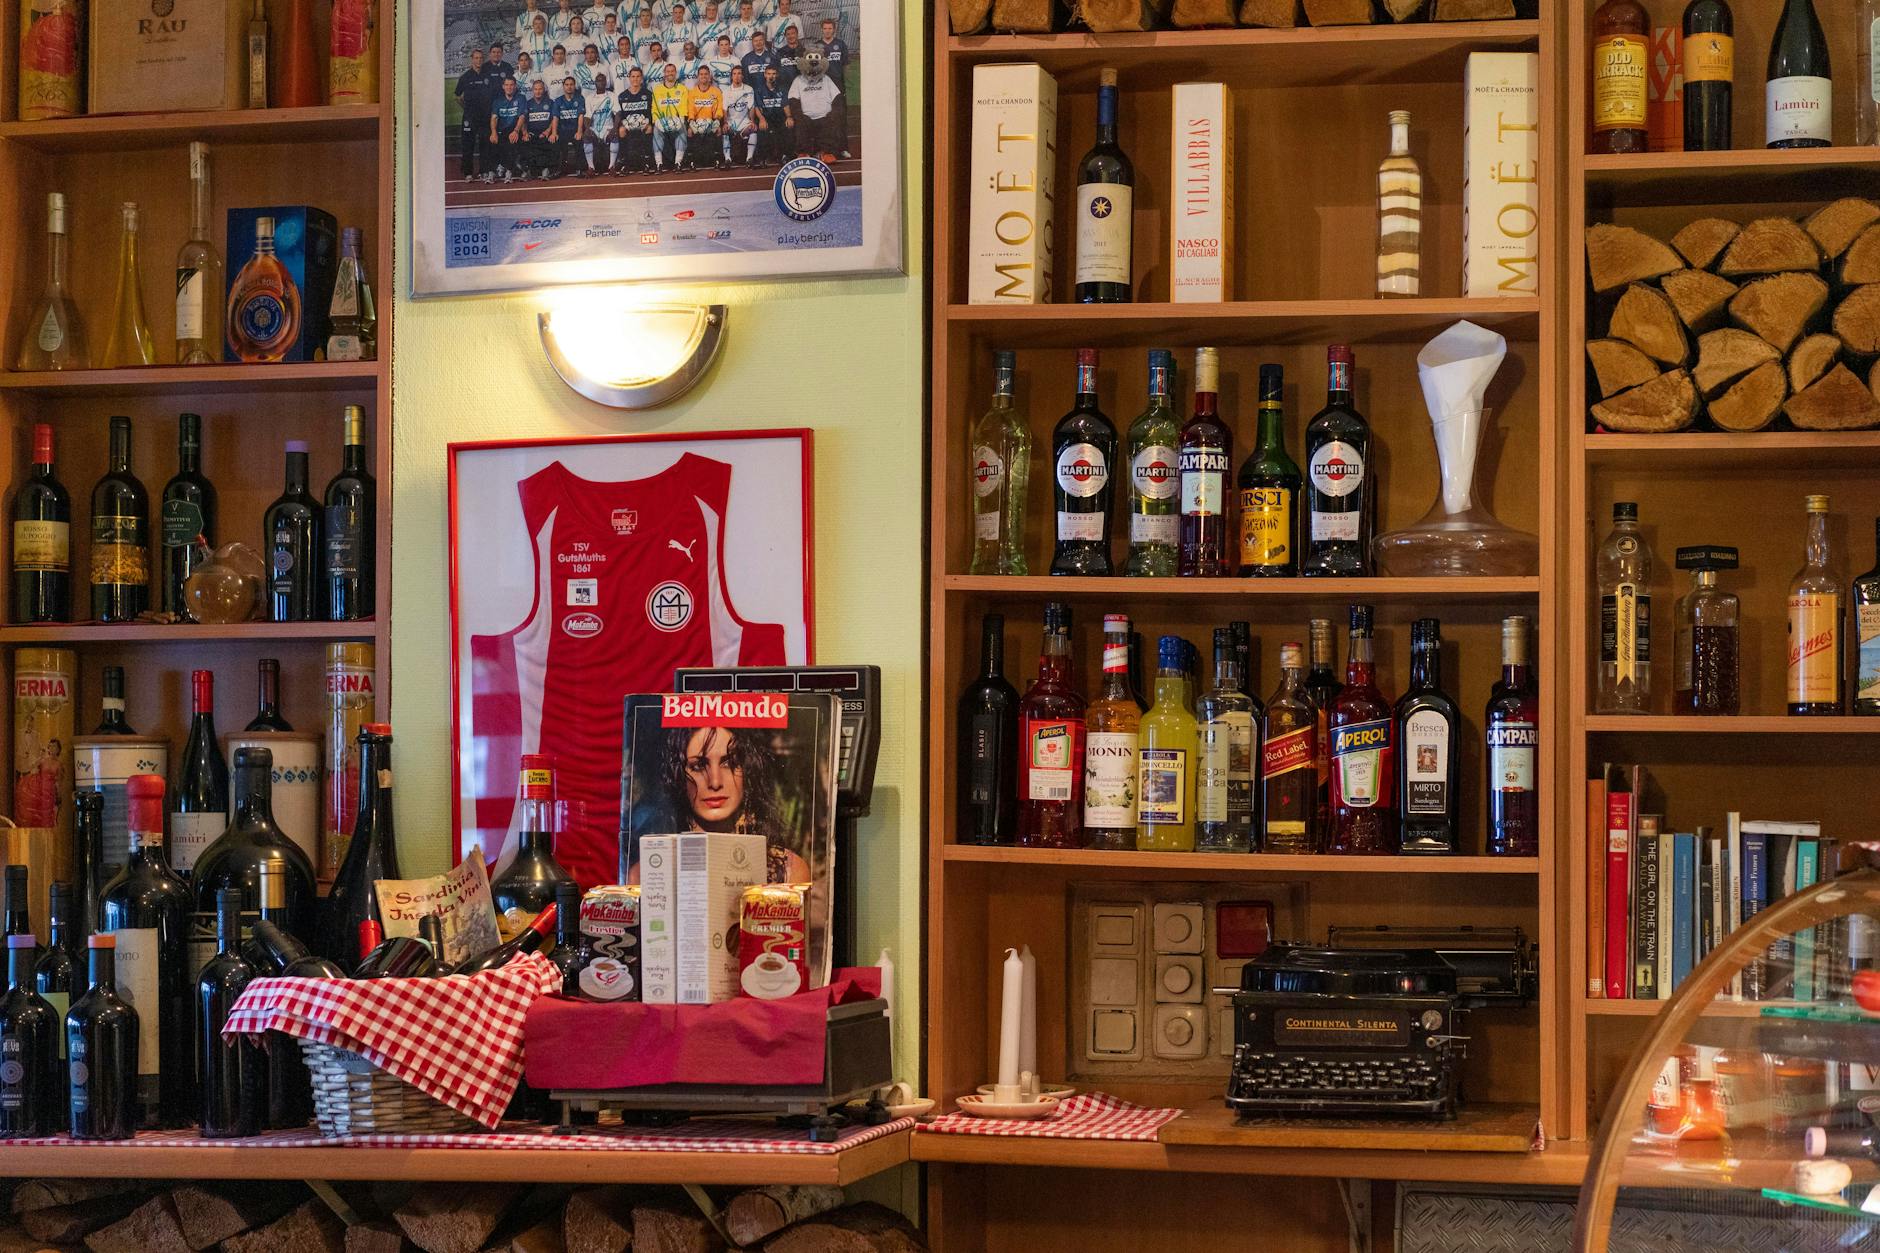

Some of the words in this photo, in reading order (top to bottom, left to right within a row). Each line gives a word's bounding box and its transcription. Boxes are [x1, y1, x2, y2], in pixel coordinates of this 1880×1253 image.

[138, 19, 188, 35] RAU
[1607, 52, 1633, 66] OLD
[1599, 64, 1644, 78] ARRACK
[1474, 86, 1495, 94] MOËT
[1500, 86, 1534, 94] CHANDON
[976, 98, 996, 106] MOËT
[1774, 98, 1820, 112] Lamùri
[779, 158, 811, 181] HERTHA
[815, 162, 831, 178] BSC
[1186, 118, 1212, 217] VILLABBAS
[1489, 111, 1538, 296] MOËT
[788, 210, 824, 222] BERLIN
[989, 123, 1036, 299] MOËT
[453, 220, 489, 232] SAISON
[510, 218, 562, 231] ARCOR
[453, 233, 489, 244] 2003
[585, 229, 622, 239] Partner
[641, 234, 658, 244] LTU
[1177, 238, 1219, 248] NASCO
[453, 245, 489, 256] 2004
[1177, 249, 1185, 258] DI
[1186, 248, 1219, 258] CAGLIARI
[1179, 454, 1229, 471] CAMPARI
[1315, 464, 1360, 475] MARTINI
[1061, 465, 1104, 476] MARTINI
[572, 542, 590, 552] TSV
[557, 552, 607, 564] GutsMuths
[572, 564, 591, 573] 1861
[663, 694, 787, 719] BelMondo
[1040, 727, 1065, 739] APEROL
[1411, 721, 1445, 733] Bresca
[1335, 727, 1387, 752] APEROL
[1486, 729, 1539, 745] CAMPARI
[1088, 747, 1132, 758] MONIN
[1265, 751, 1283, 763] Red
[1284, 740, 1309, 755] Label
[1413, 783, 1441, 792] MIRTO
[1648, 840, 1656, 860] THE
[1640, 855, 1648, 890] PAULA
[1750, 854, 1759, 879] Frauen
[1648, 863, 1656, 888] GIRL
[395, 870, 474, 905] Sardinia
[457, 881, 483, 905] Vini
[1648, 890, 1656, 907] ON
[580, 901, 635, 921] Mokambo
[743, 901, 801, 921] Mokambo
[1639, 894, 1647, 947] HAWKINS
[1647, 909, 1656, 929] THE
[750, 924, 793, 934] PREMIER
[1647, 931, 1656, 960] TRAIN
[1286, 1018, 1351, 1028] CONTINENTAL
[1357, 1019, 1398, 1029] SILENTA
